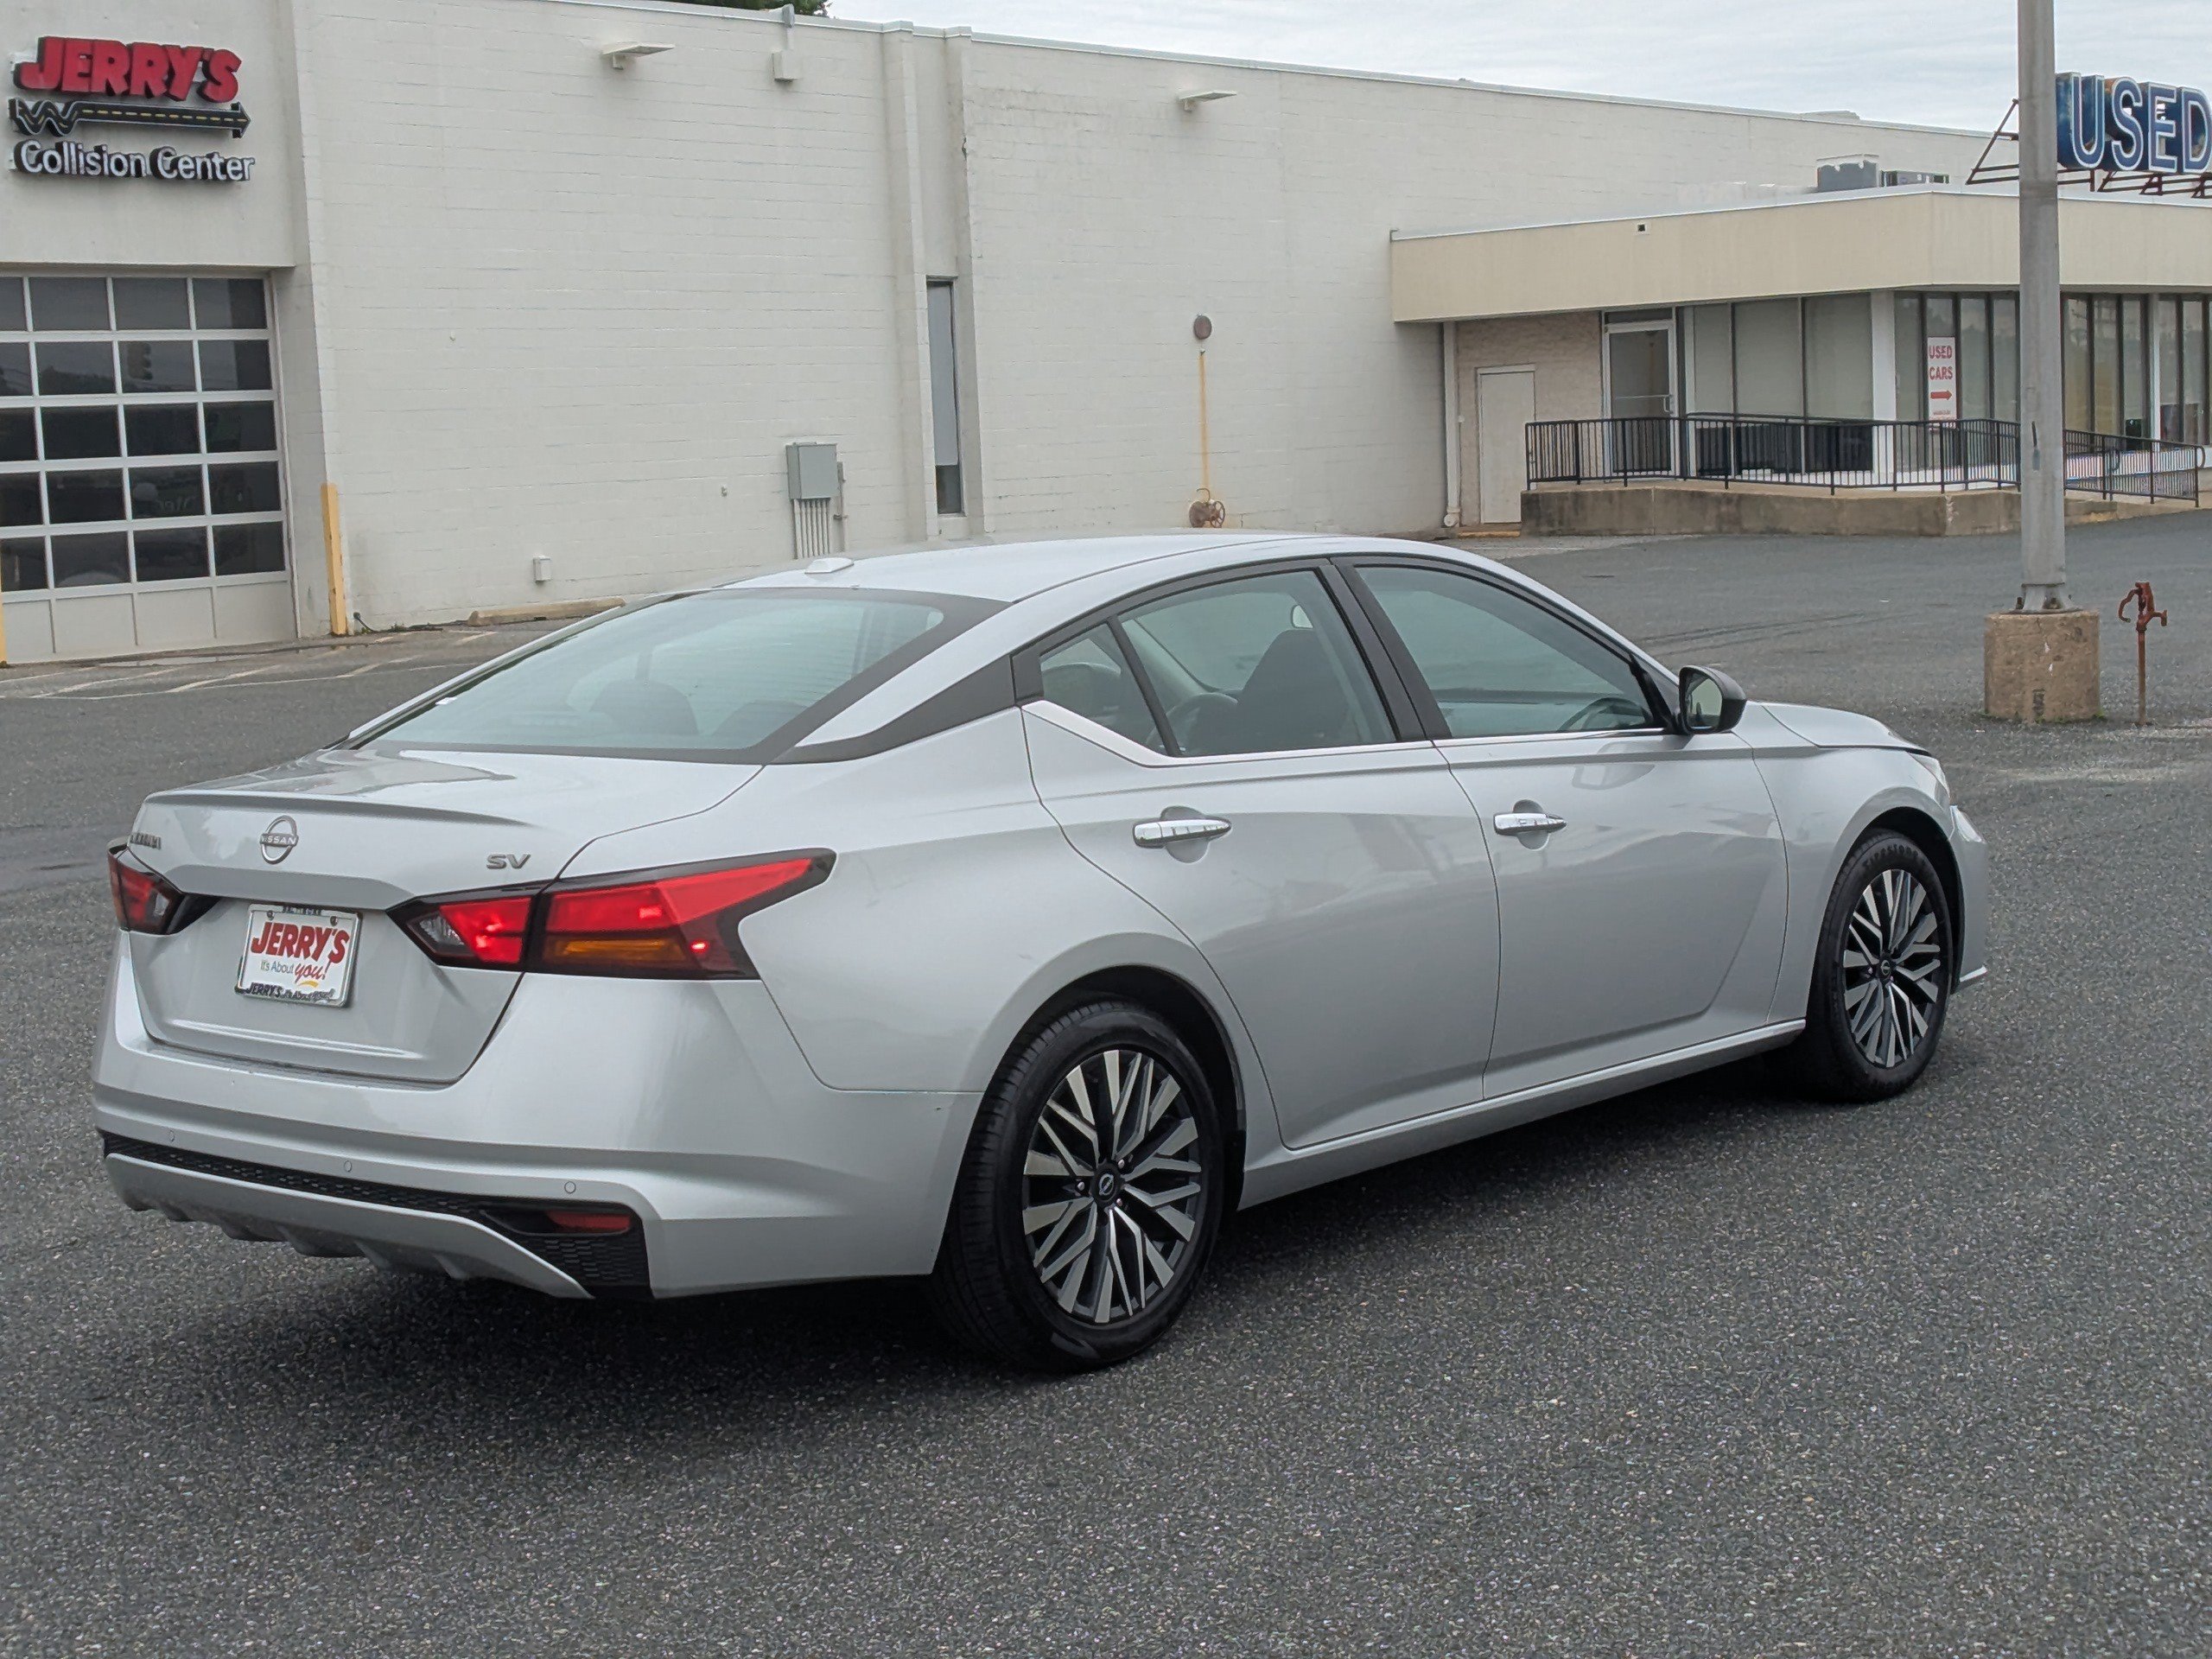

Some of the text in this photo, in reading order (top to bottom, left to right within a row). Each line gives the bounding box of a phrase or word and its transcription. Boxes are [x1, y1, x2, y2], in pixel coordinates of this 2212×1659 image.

[14, 36, 242, 103] JERRY'S
[2057, 72, 2212, 173] USED
[15, 139, 256, 181] Collision Center
[1929, 346, 1953, 359] USED
[1929, 365, 1954, 380] CARS
[486, 854, 531, 869] SV
[251, 922, 349, 963] JERRY'S
[270, 960, 295, 974] About
